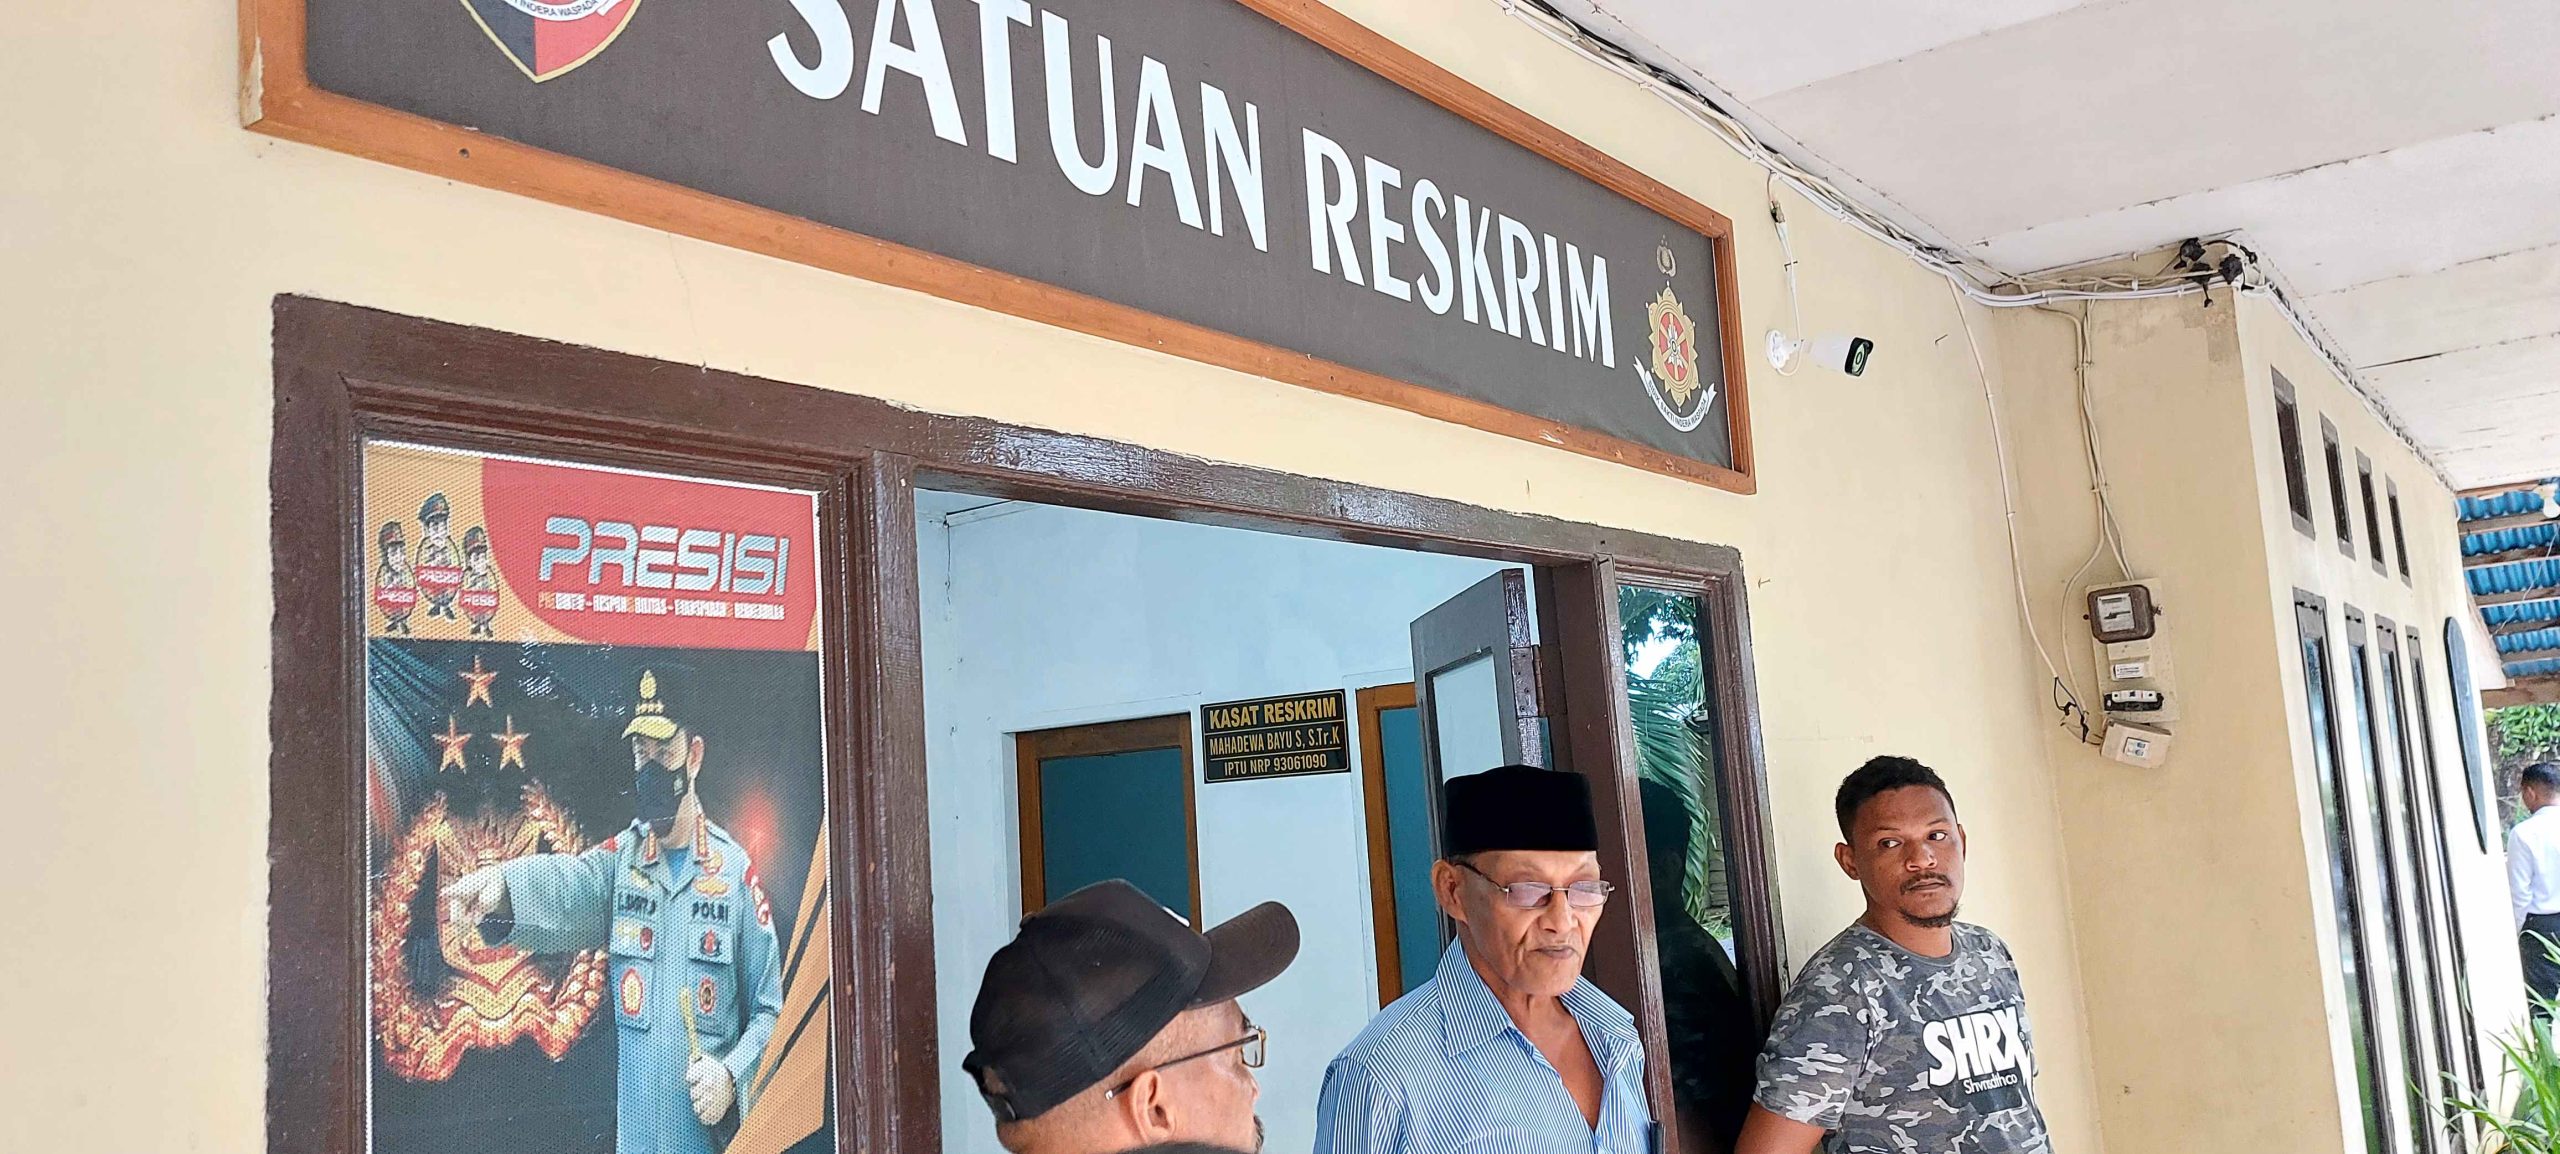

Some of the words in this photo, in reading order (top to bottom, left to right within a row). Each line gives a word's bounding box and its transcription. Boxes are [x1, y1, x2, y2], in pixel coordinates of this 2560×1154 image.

[560, 0, 599, 16] WASPADA
[767, 0, 1267, 253] SATUAN
[1302, 127, 1615, 368] RESKRIM
[538, 516, 790, 596] PRESISI
[1209, 705, 1259, 729] KASAT
[1264, 696, 1337, 724] RESKRIM
[1209, 733, 1265, 756] MAHADEWA
[1267, 730, 1293, 750] BAYU
[1295, 730, 1306, 750] S,
[1224, 759, 1247, 777] IPTU
[1250, 757, 1271, 774] NRP
[1273, 753, 1327, 772] 93061090
[1923, 1005, 2029, 1087] SHRX
